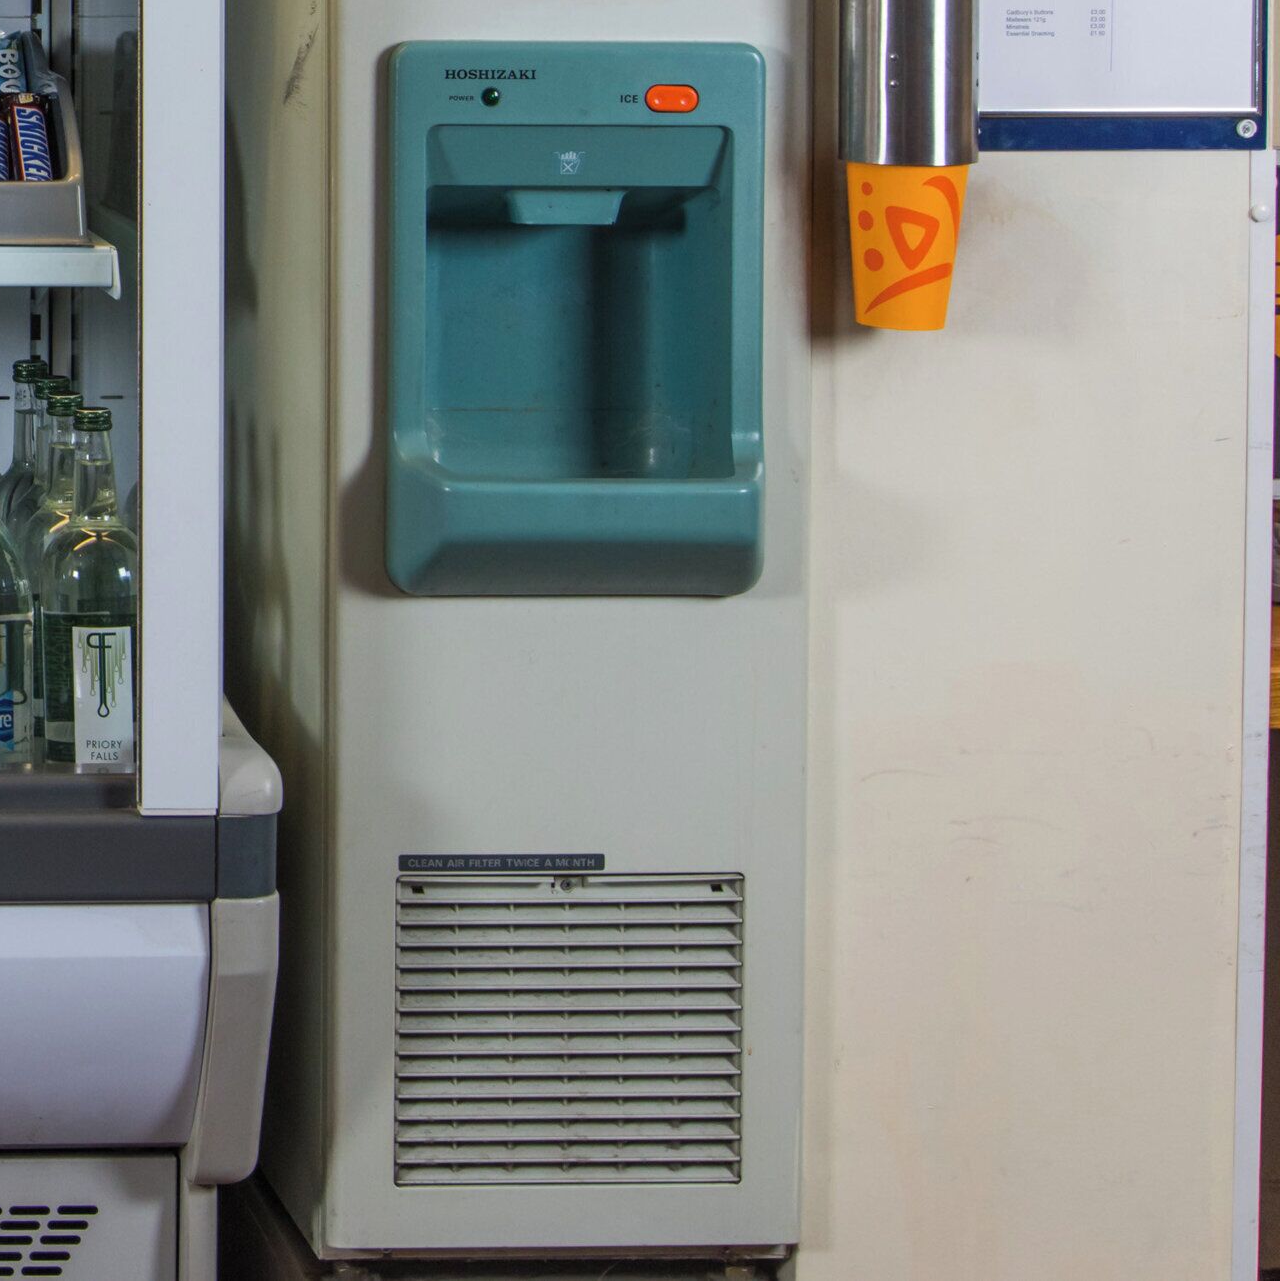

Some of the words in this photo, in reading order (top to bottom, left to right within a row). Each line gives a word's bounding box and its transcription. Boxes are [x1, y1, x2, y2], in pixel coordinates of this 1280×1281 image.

[443, 69, 537, 80] HOSHIZAKI
[619, 94, 639, 104] ICE
[86, 739, 123, 749] PRIORY
[90, 751, 119, 761] FALLS
[407, 858, 443, 868] CLEAN
[446, 858, 465, 868] AIR
[468, 858, 501, 868] FILTER
[507, 858, 540, 868] TWICE
[544, 858, 552, 867] A
